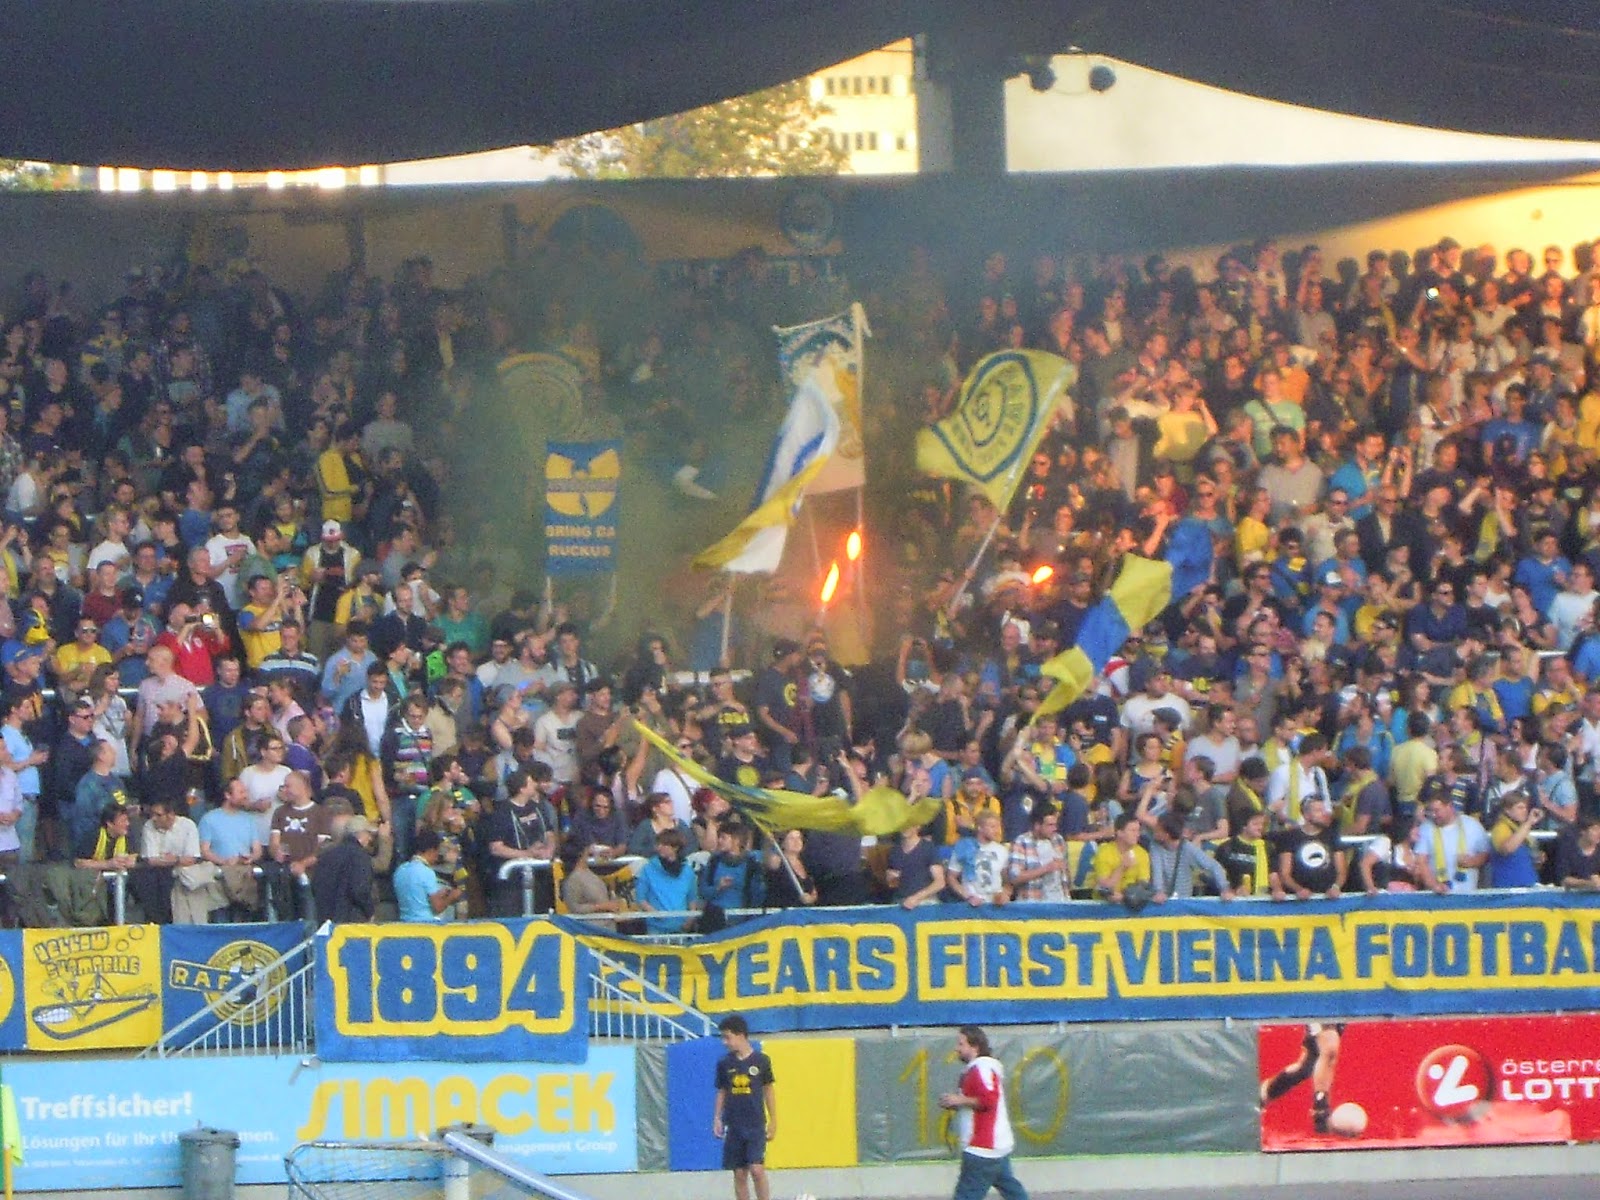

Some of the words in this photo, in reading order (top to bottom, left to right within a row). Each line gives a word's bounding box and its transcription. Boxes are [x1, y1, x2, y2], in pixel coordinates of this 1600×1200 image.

[548, 545, 611, 557] RUCKUS
[699, 934, 896, 1000] YEARS
[928, 930, 1100, 988] FIRST
[1115, 925, 1342, 984] VIENNA
[1356, 920, 1600, 979] FOOTBA
[338, 934, 564, 1021] 1894
[22, 1092, 193, 1120] Treffsicher!
[297, 1073, 615, 1140] SIMACEK
[23, 1136, 100, 1152] Lösungen
[105, 1132, 129, 1146] für
[575, 1140, 618, 1153] Group
